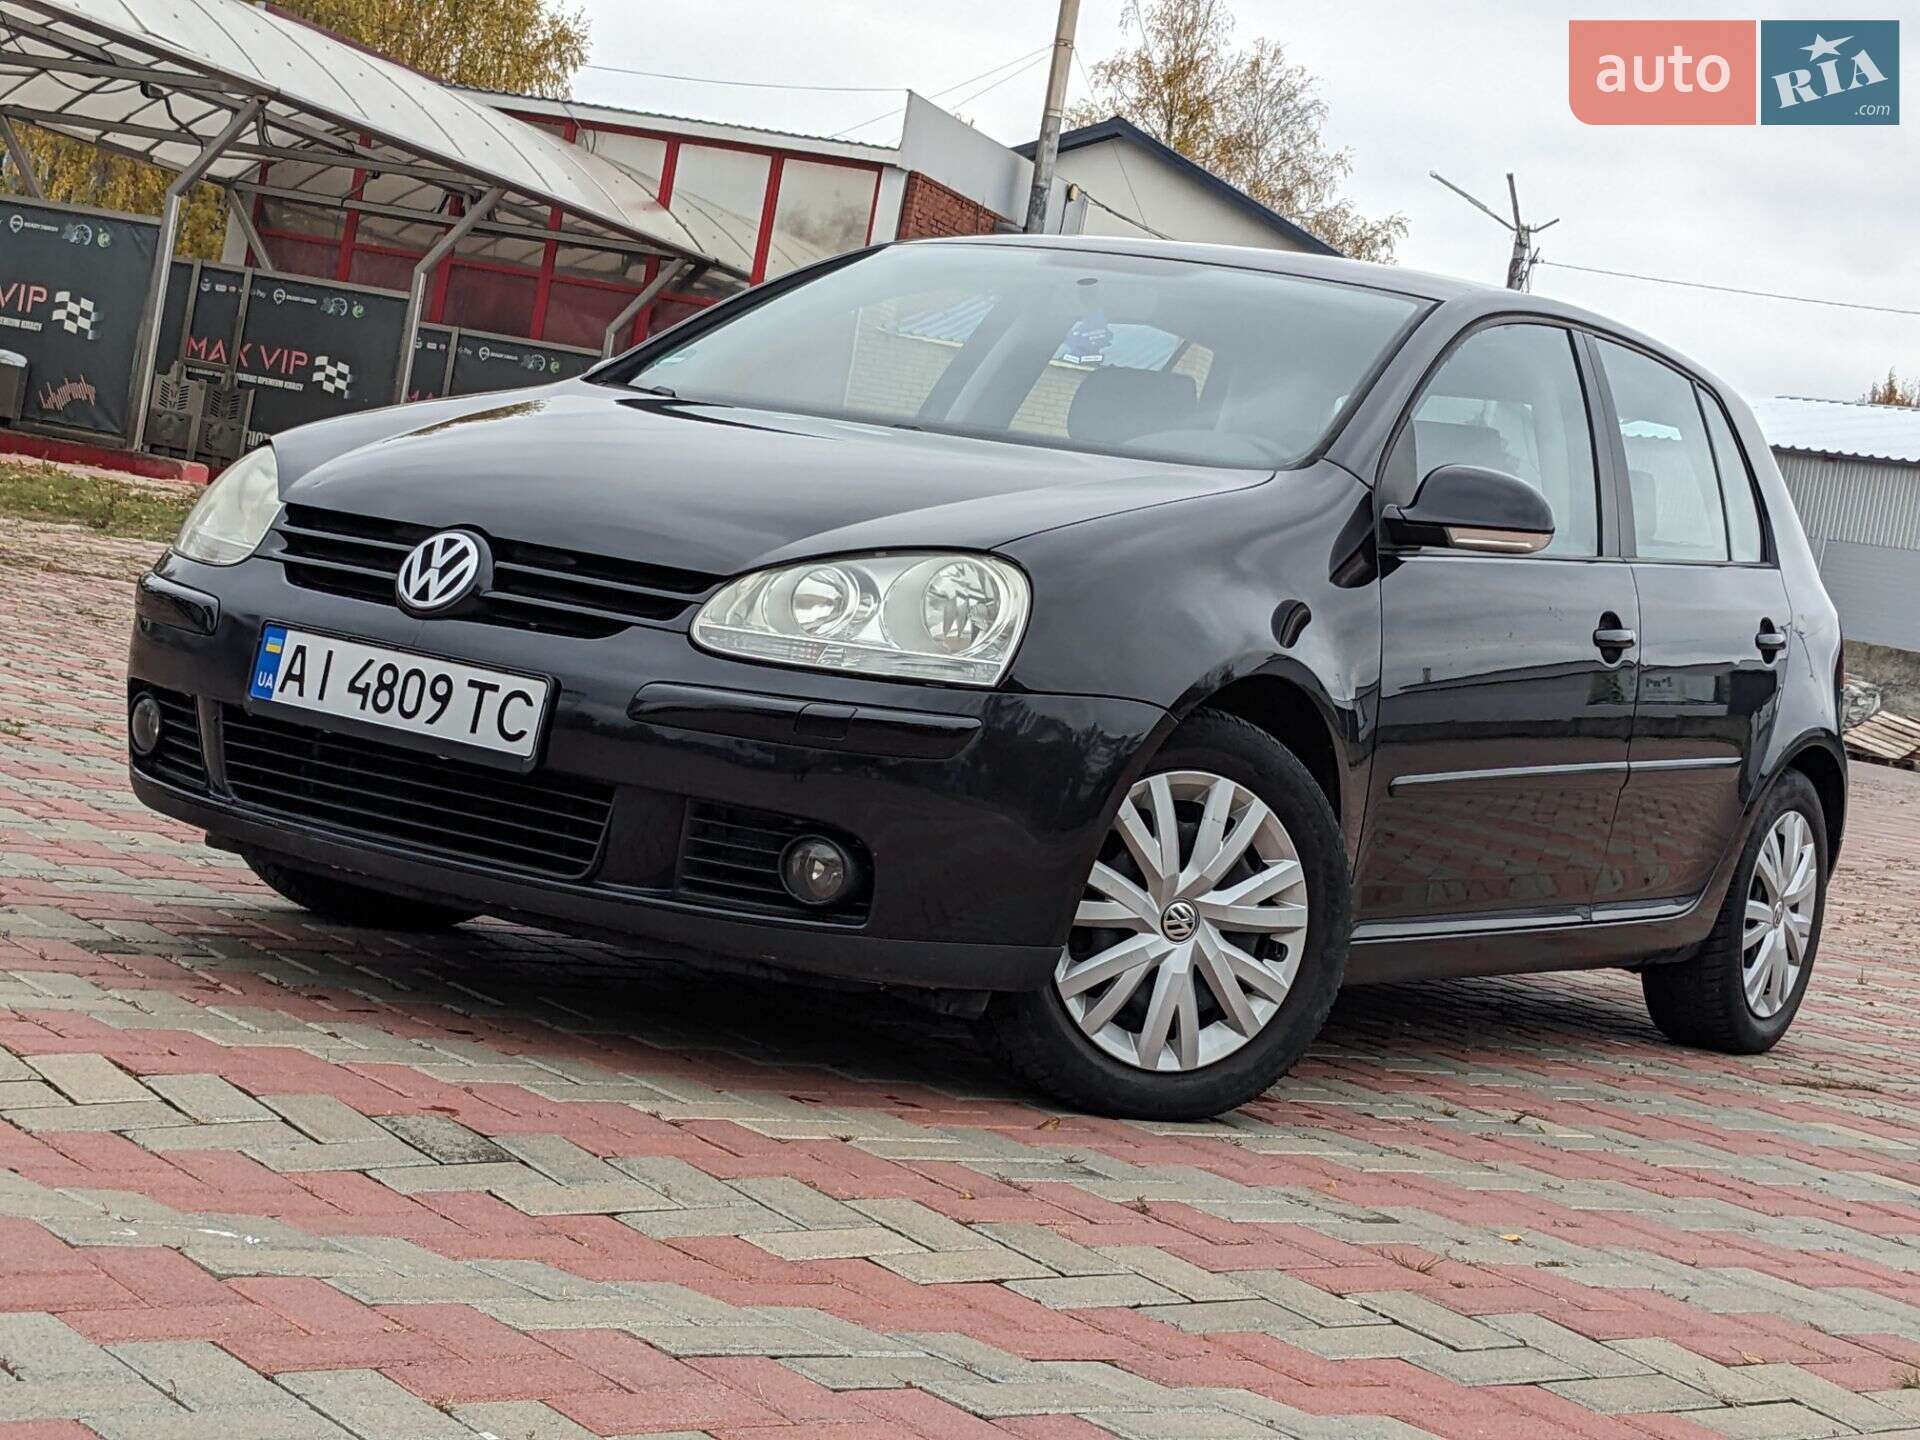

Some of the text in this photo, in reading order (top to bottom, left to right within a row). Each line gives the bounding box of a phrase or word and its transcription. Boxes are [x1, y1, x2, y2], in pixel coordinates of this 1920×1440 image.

[260, 345, 309, 375] VIP
[257, 671, 274, 690] UA
[278, 645, 534, 743] AI 4809 TC
